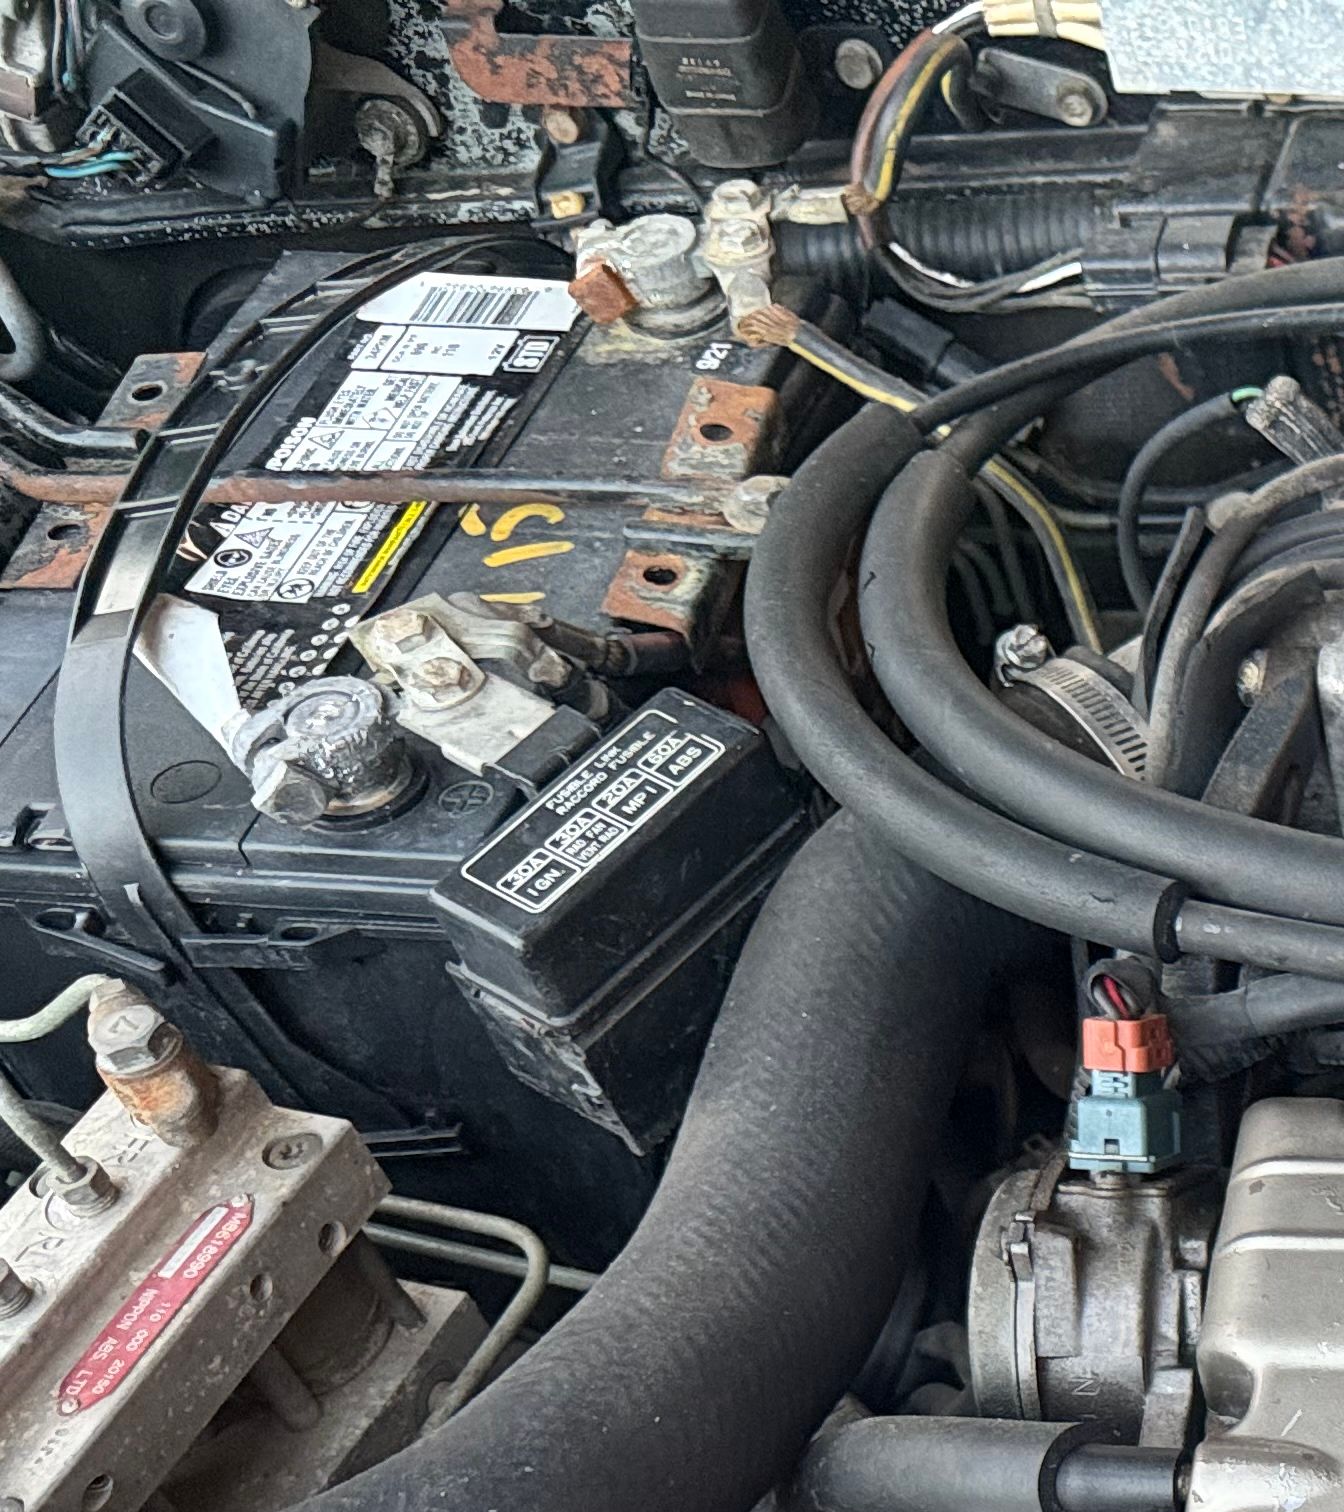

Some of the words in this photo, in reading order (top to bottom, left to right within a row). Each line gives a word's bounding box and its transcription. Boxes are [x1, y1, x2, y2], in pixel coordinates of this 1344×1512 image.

[695, 342, 733, 371] 9/21
[646, 735, 684, 764] 60A
[670, 747, 703, 777] ABS
[546, 769, 594, 809] FUSIBLE
[594, 747, 623, 769] LINK
[556, 772, 609, 816] RACCORD
[609, 731, 657, 770] FUSIBLE
[600, 775, 639, 806] 20A
[555, 813, 592, 846] 30A
[588, 823, 608, 839] FAN
[507, 853, 546, 886] 30A
[116, 1288, 160, 1331] NIPPON
[66, 1369, 94, 1396] LTD
